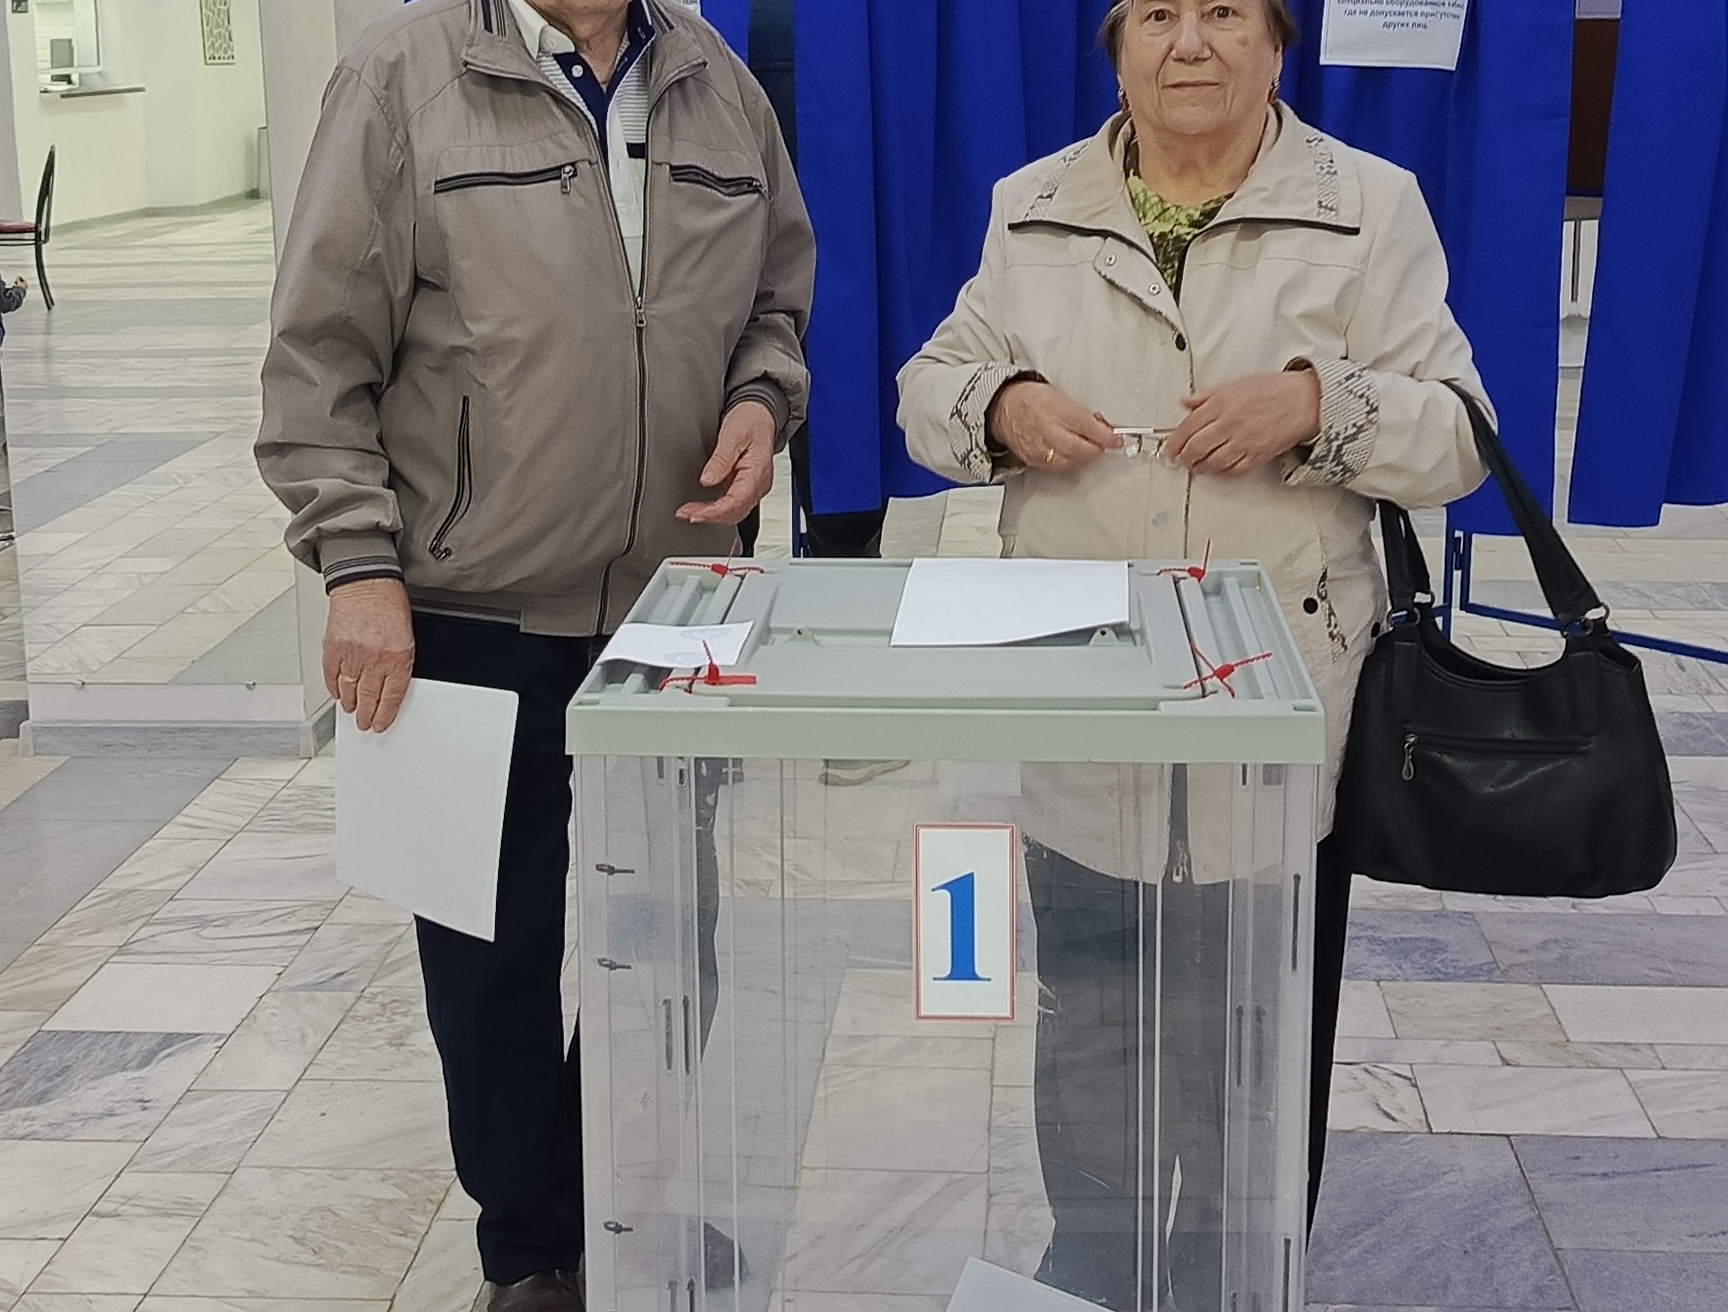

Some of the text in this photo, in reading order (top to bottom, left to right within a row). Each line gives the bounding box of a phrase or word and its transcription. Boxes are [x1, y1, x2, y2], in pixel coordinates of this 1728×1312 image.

[1344, 9, 1357, 17] где
[1370, 10, 1419, 19] допускается
[1382, 21, 1409, 30] других
[931, 871, 992, 982] 1
